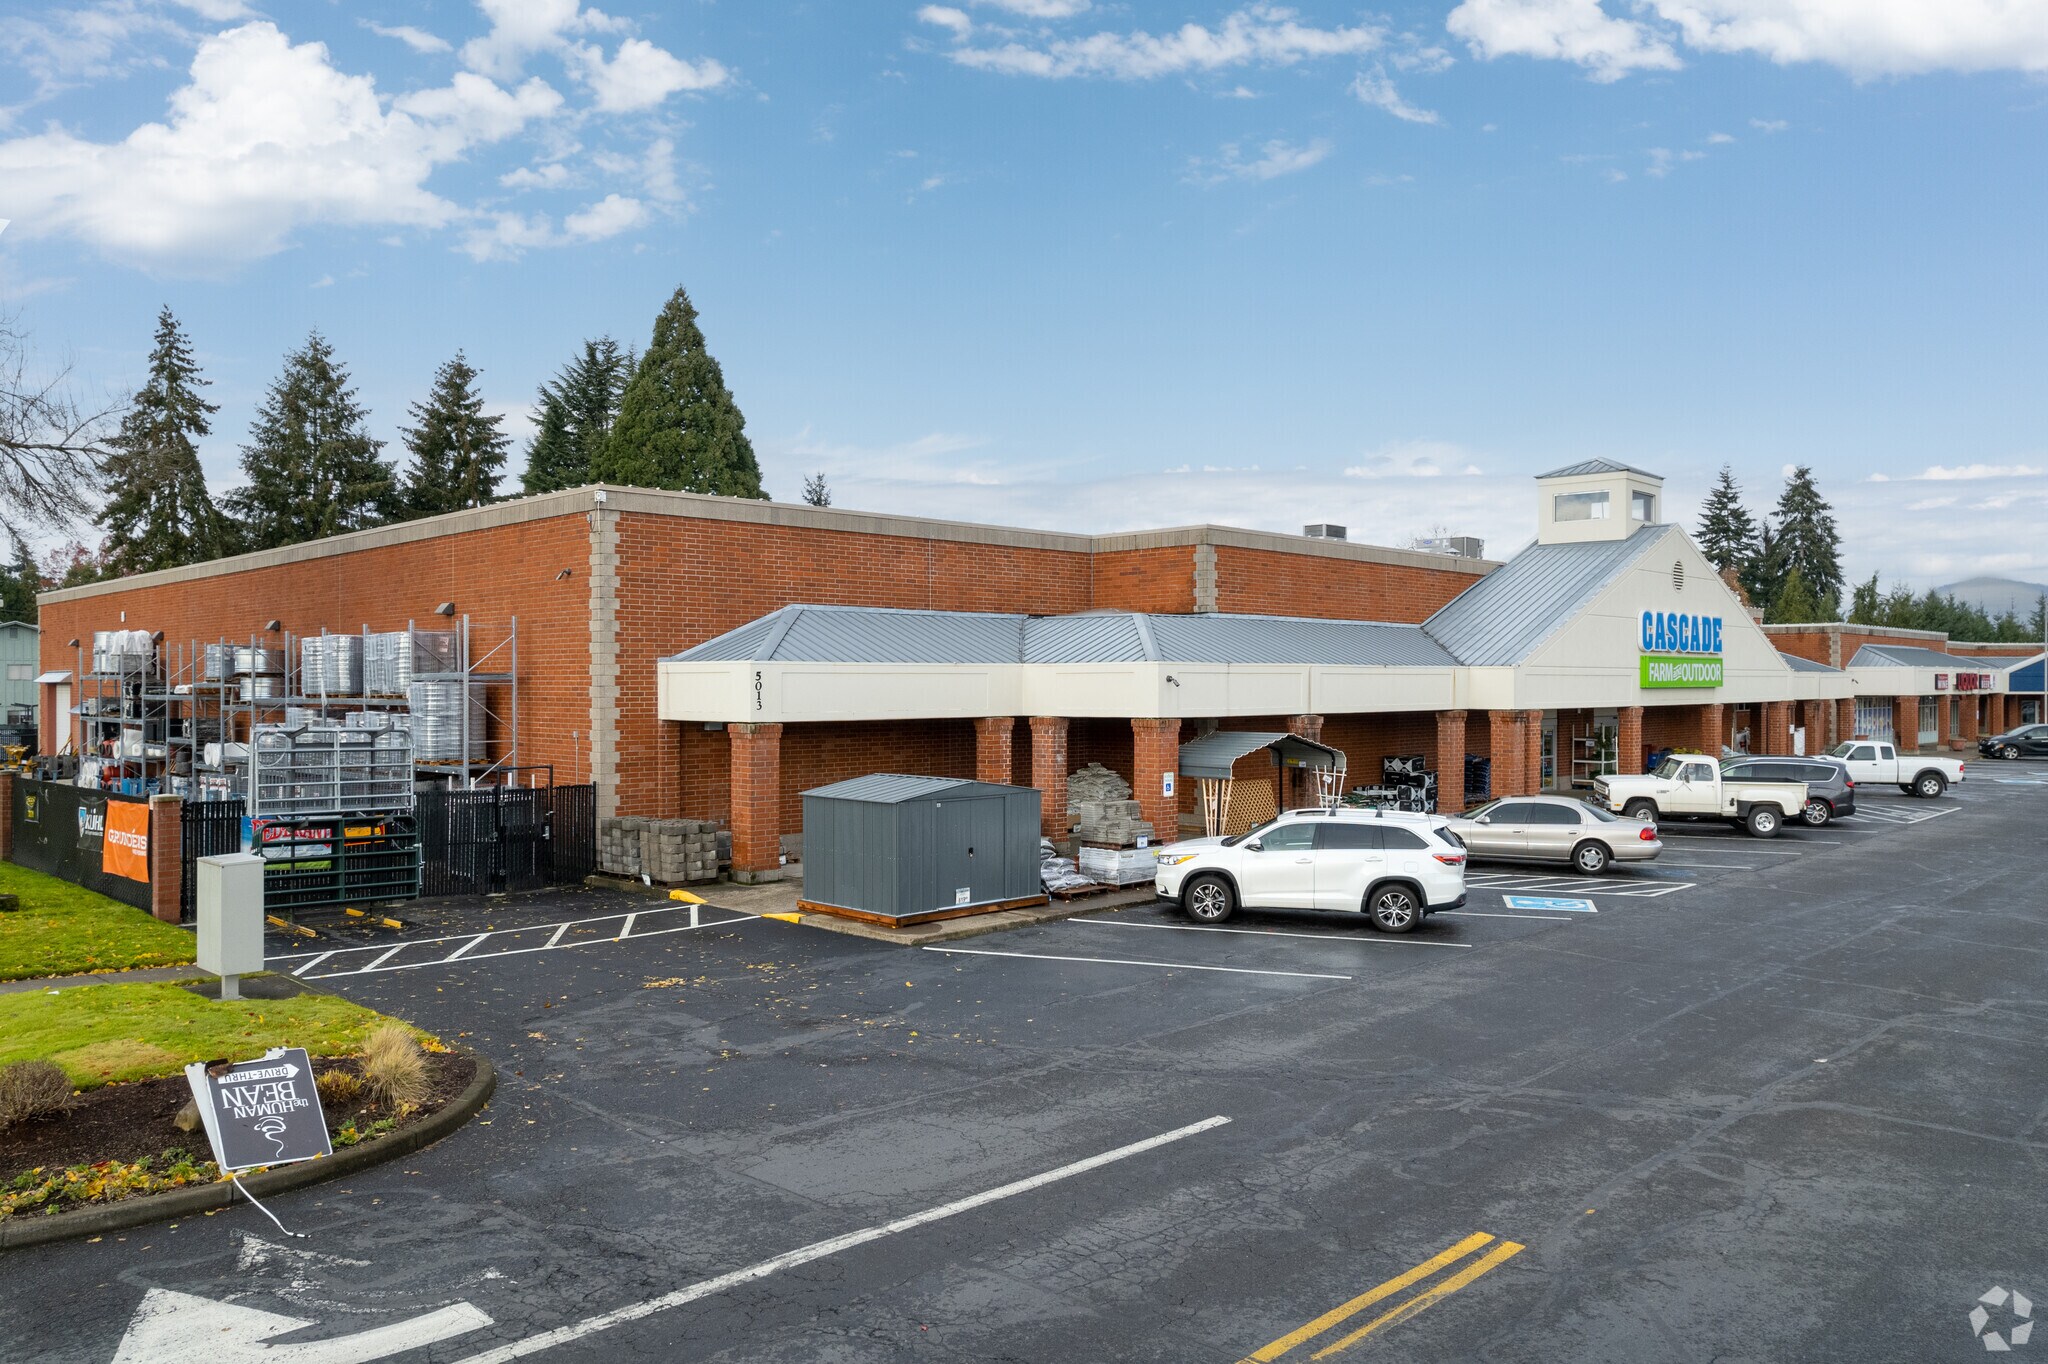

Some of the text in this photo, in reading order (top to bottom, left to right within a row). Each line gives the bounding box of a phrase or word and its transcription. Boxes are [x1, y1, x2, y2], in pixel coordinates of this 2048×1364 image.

[1642, 611, 1722, 652] CASCADE
[1649, 662, 1673, 682] FARM
[1682, 663, 1721, 682] OUTDOOR
[224, 1066, 289, 1083] DRIVE-THRU
[221, 1080, 296, 1109] BEAN
[233, 1098, 309, 1119] the HUMAN
